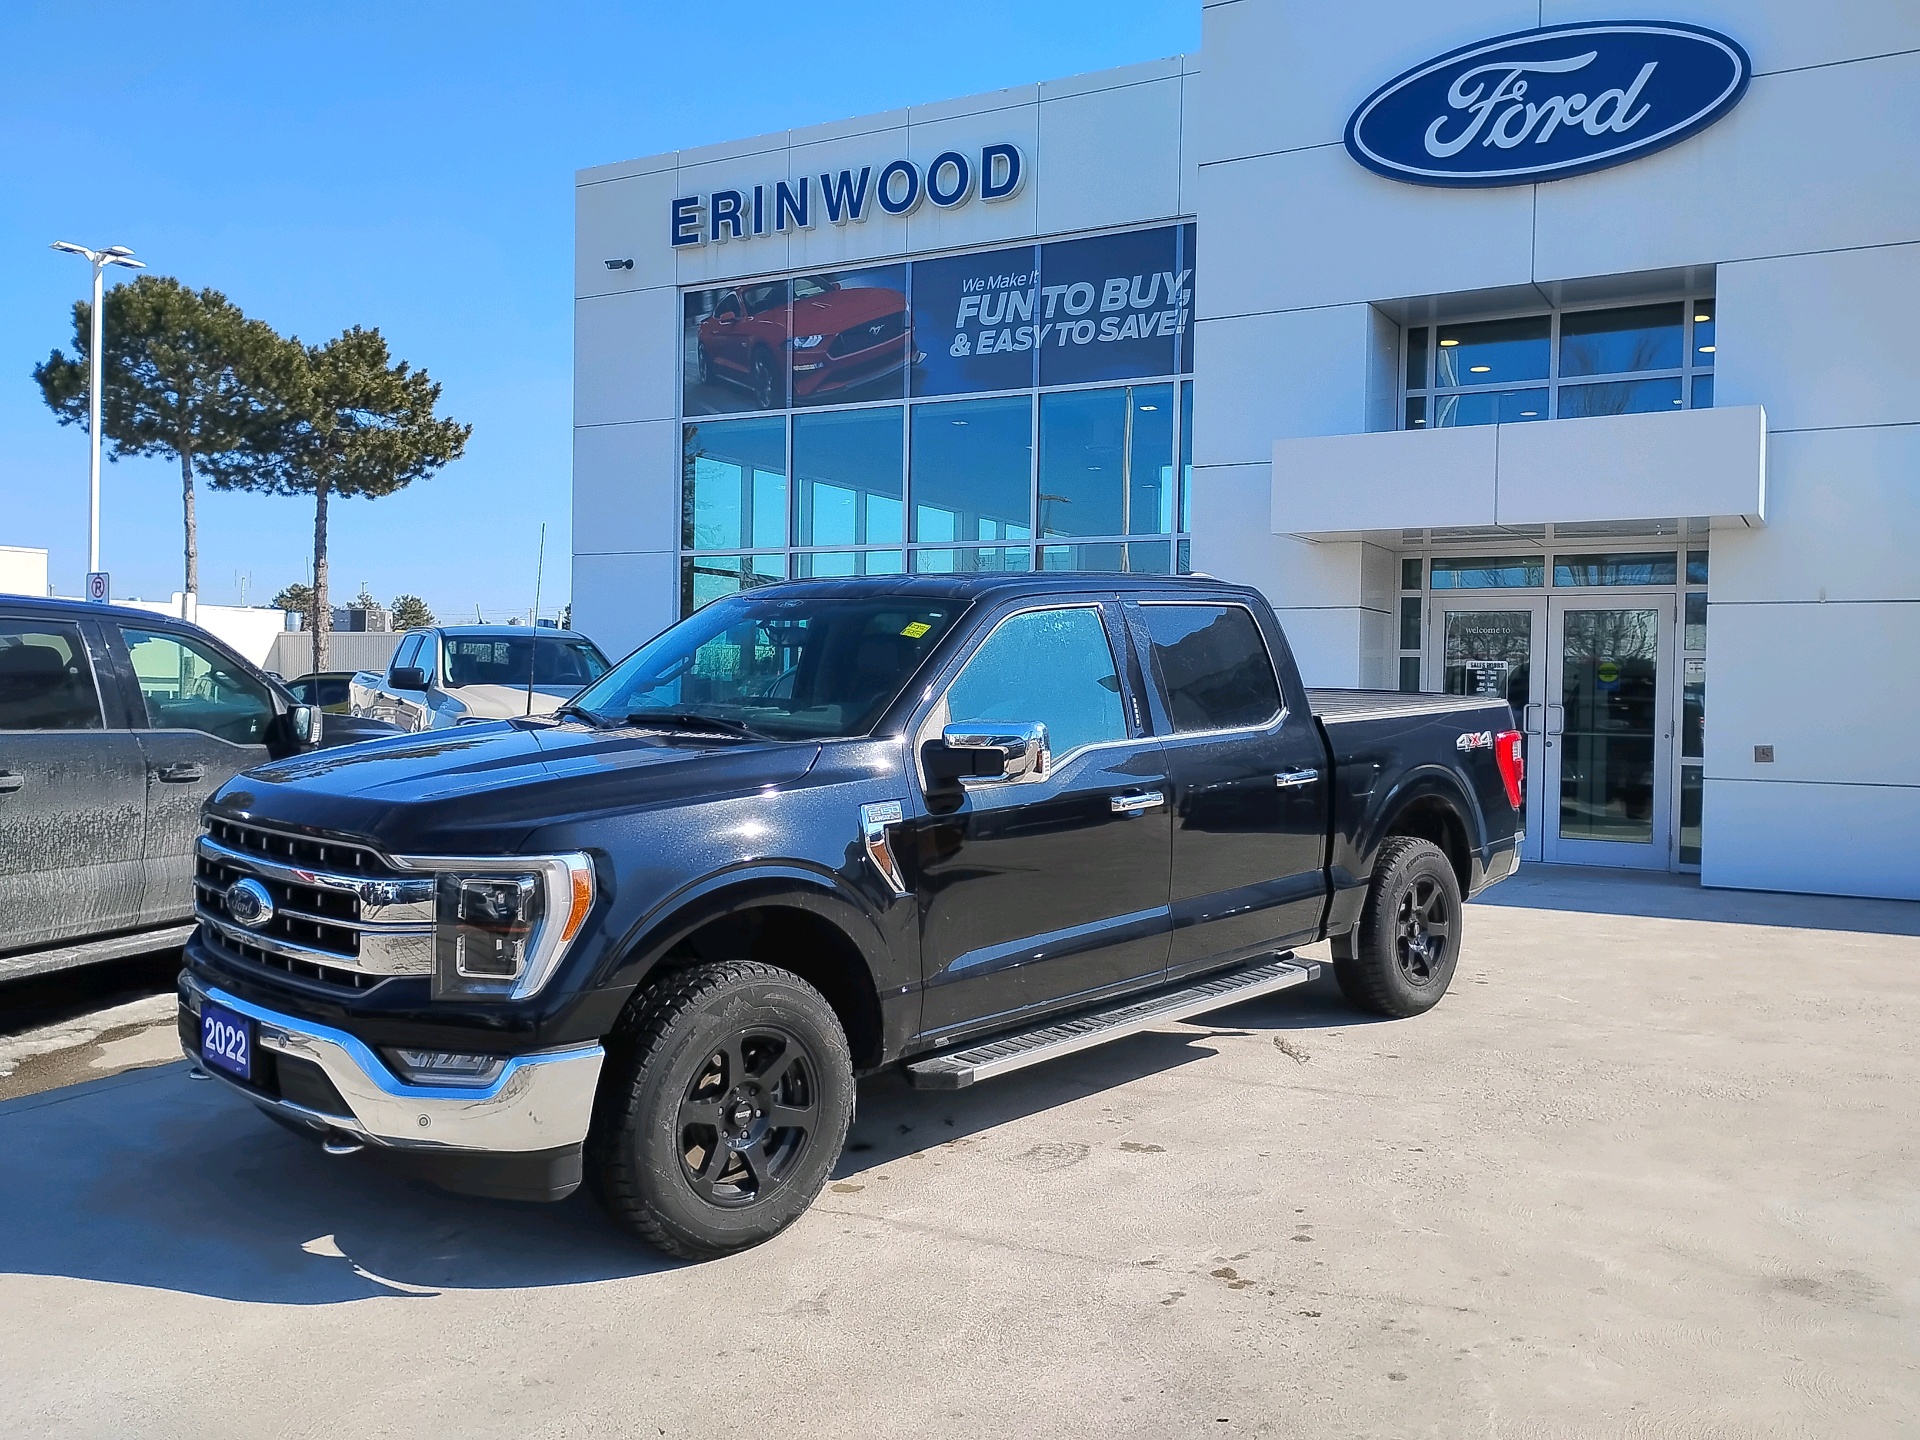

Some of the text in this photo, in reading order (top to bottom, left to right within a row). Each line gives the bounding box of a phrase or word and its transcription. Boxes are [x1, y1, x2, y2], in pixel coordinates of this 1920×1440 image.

[1424, 50, 1659, 158] Ford
[670, 142, 1024, 250] ERINWOOD
[955, 288, 1036, 329] FUN
[1041, 281, 1095, 319] TO
[962, 269, 1040, 293] We Make It
[949, 308, 1190, 357] & EASY TO SAVE!
[1465, 626, 1511, 634] welcome to
[231, 889, 253, 915] Ford
[205, 1016, 247, 1066] 2022
